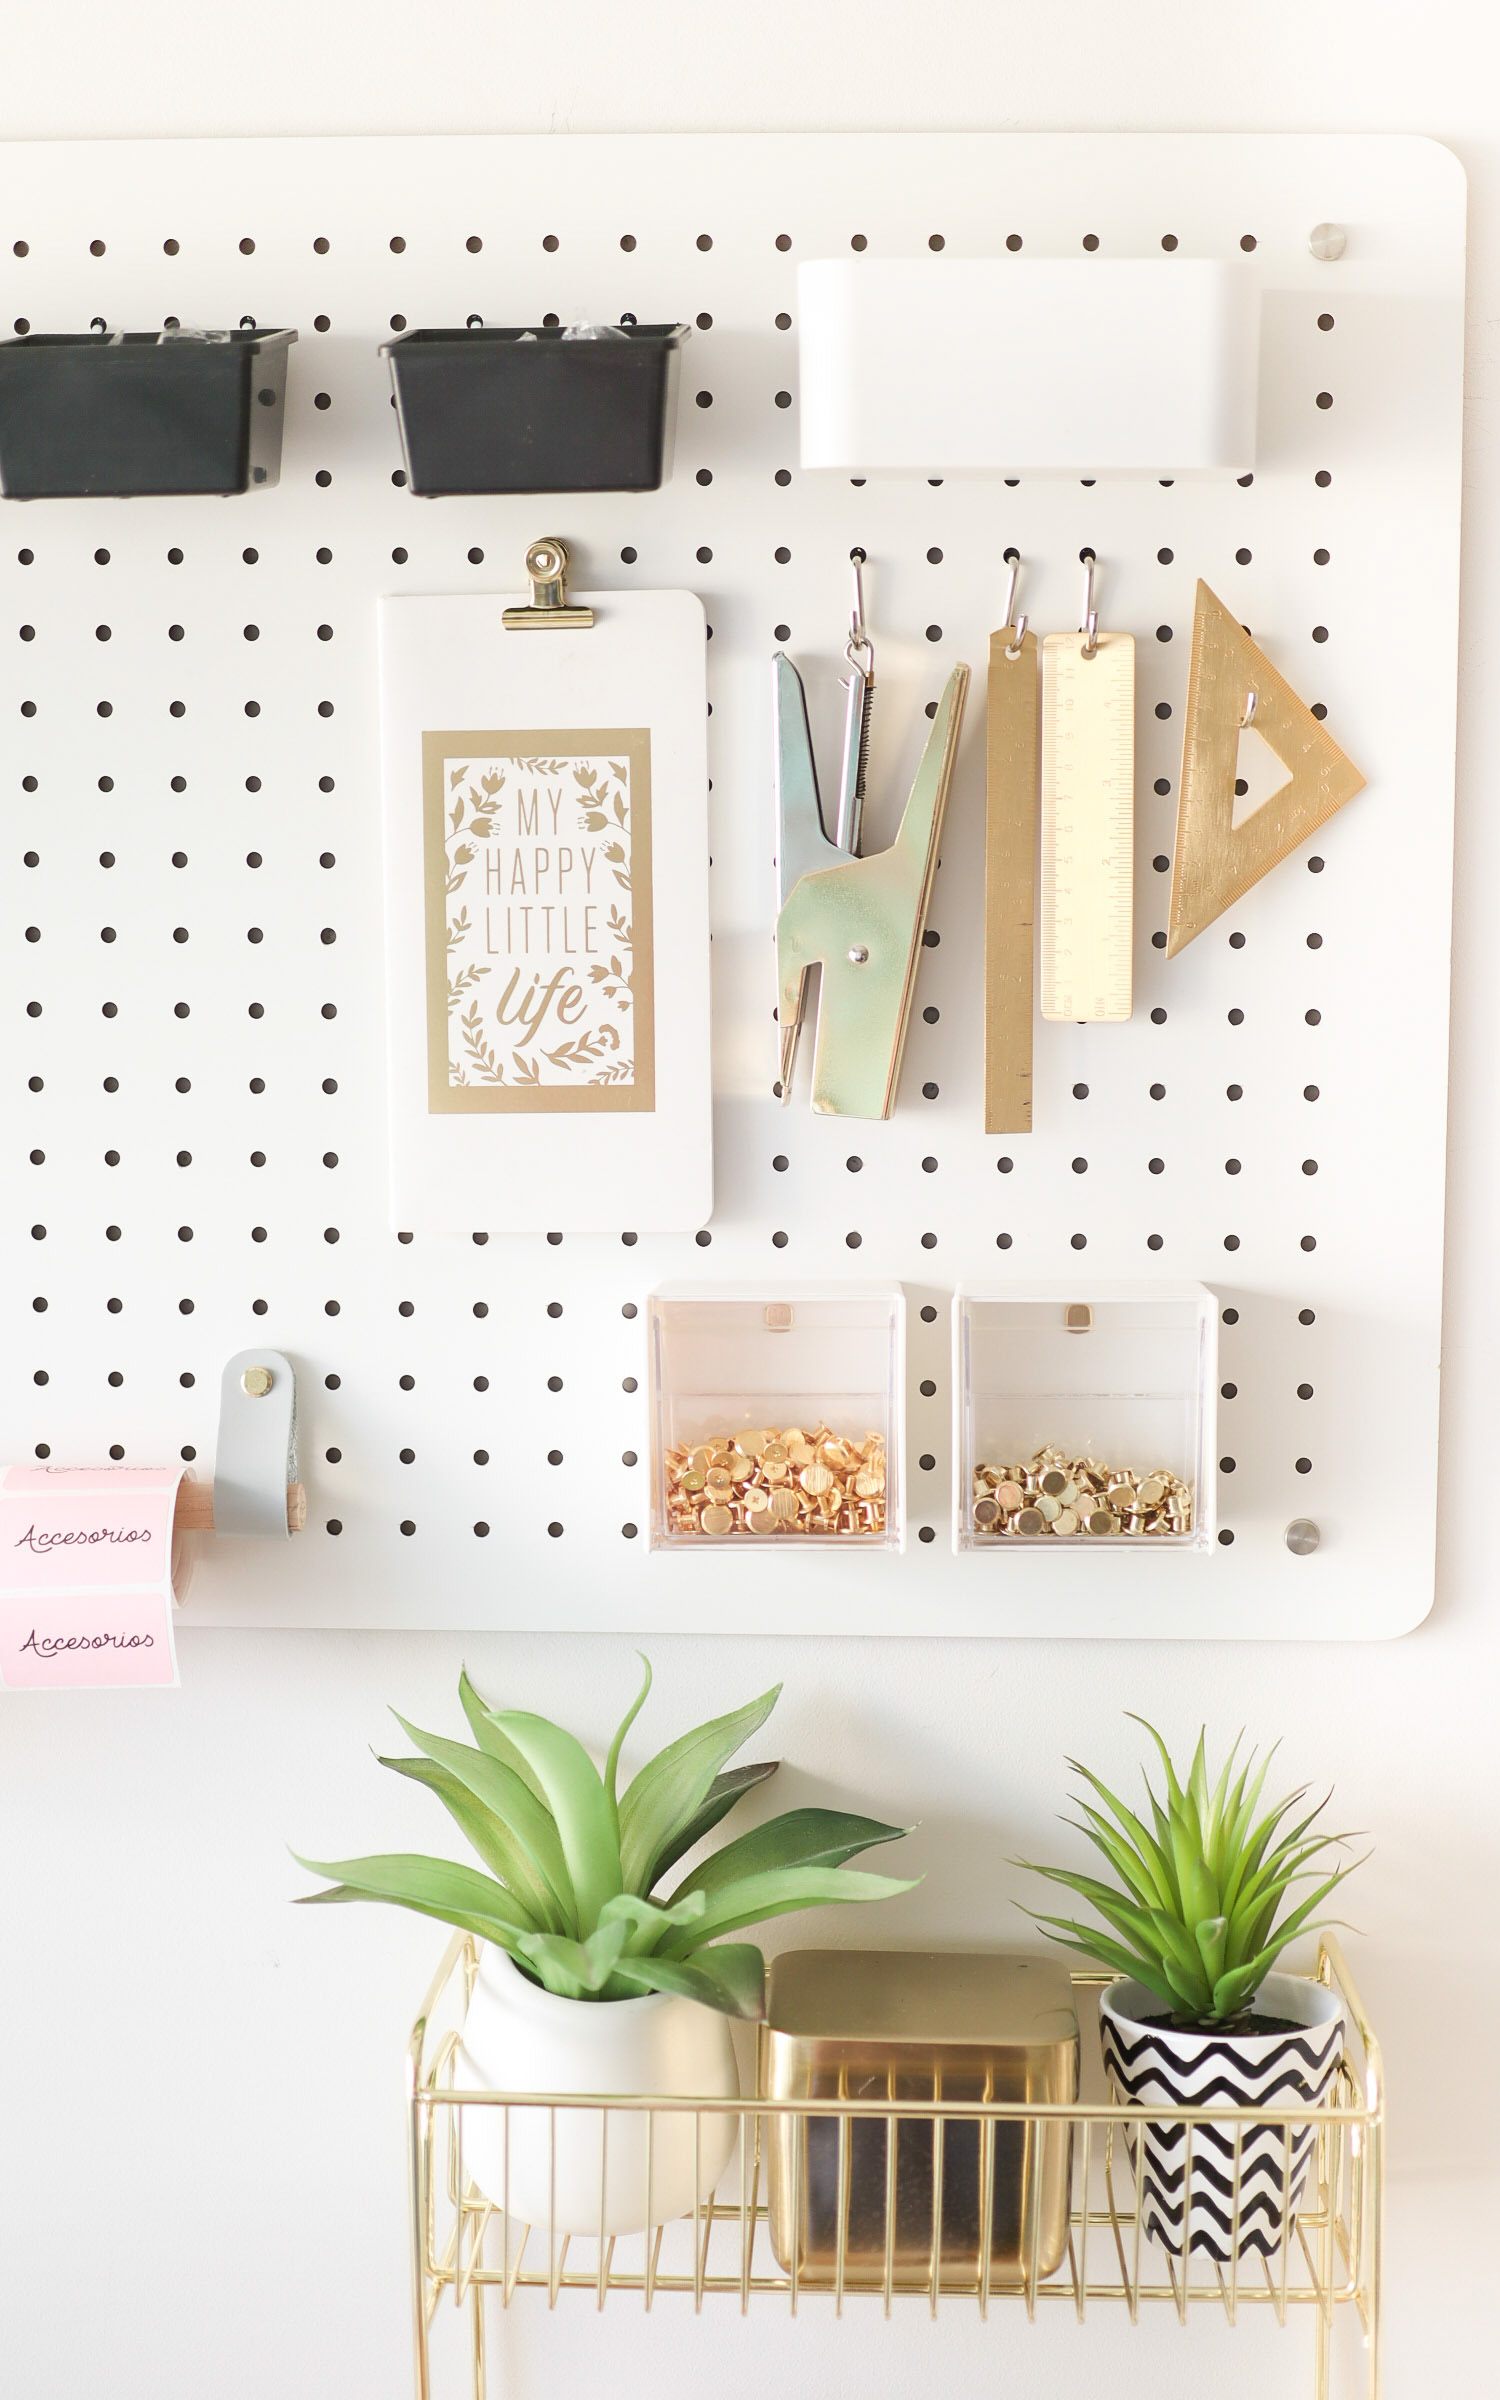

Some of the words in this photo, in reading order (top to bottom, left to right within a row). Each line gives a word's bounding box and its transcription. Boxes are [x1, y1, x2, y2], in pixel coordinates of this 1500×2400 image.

[1065, 667, 1074, 679] 11
[1065, 697, 1074, 711] 10
[1102, 779, 1111, 787] 3
[518, 788, 562, 836] MY
[486, 847, 596, 895] HAPPY
[1064, 855, 1073, 864] 5
[486, 906, 598, 954] LITTLE
[1064, 917, 1073, 925] 3
[496, 966, 588, 1048] life
[14, 1524, 152, 1553] Accesorios
[19, 1629, 154, 1658] Accesorios
